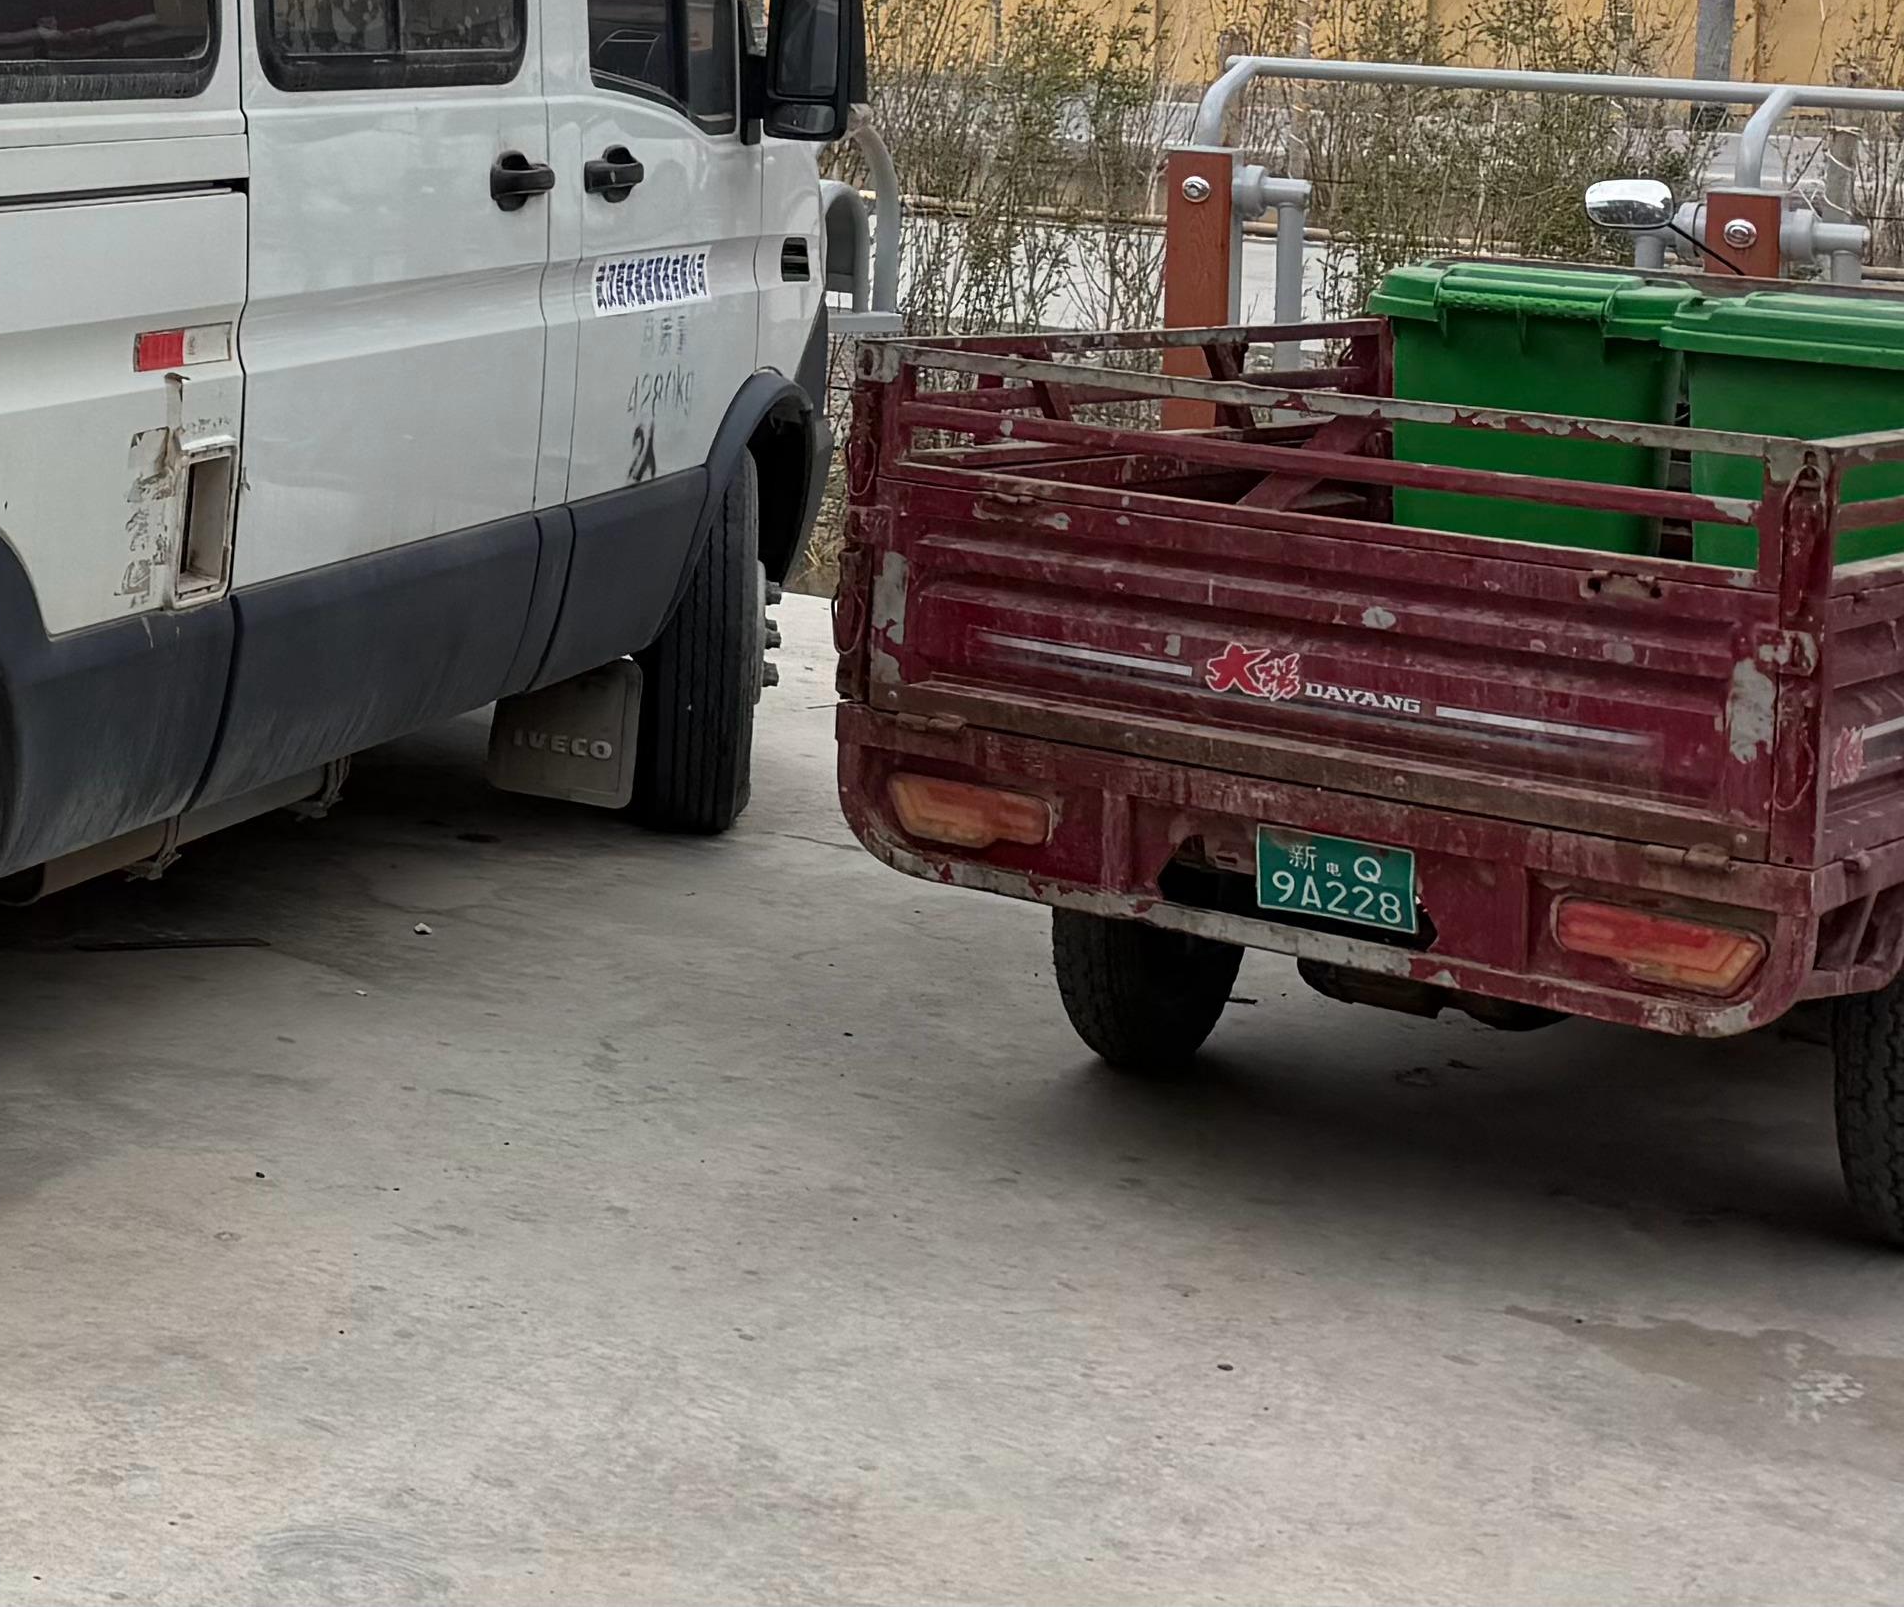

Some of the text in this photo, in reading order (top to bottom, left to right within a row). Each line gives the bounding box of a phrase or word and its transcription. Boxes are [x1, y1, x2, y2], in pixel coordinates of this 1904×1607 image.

[1305, 681, 1421, 714] DAYANG
[513, 727, 613, 760] IVECO
[1289, 844, 1318, 872] 新
[1353, 856, 1382, 884] Q
[1272, 870, 1402, 924] 9A228
